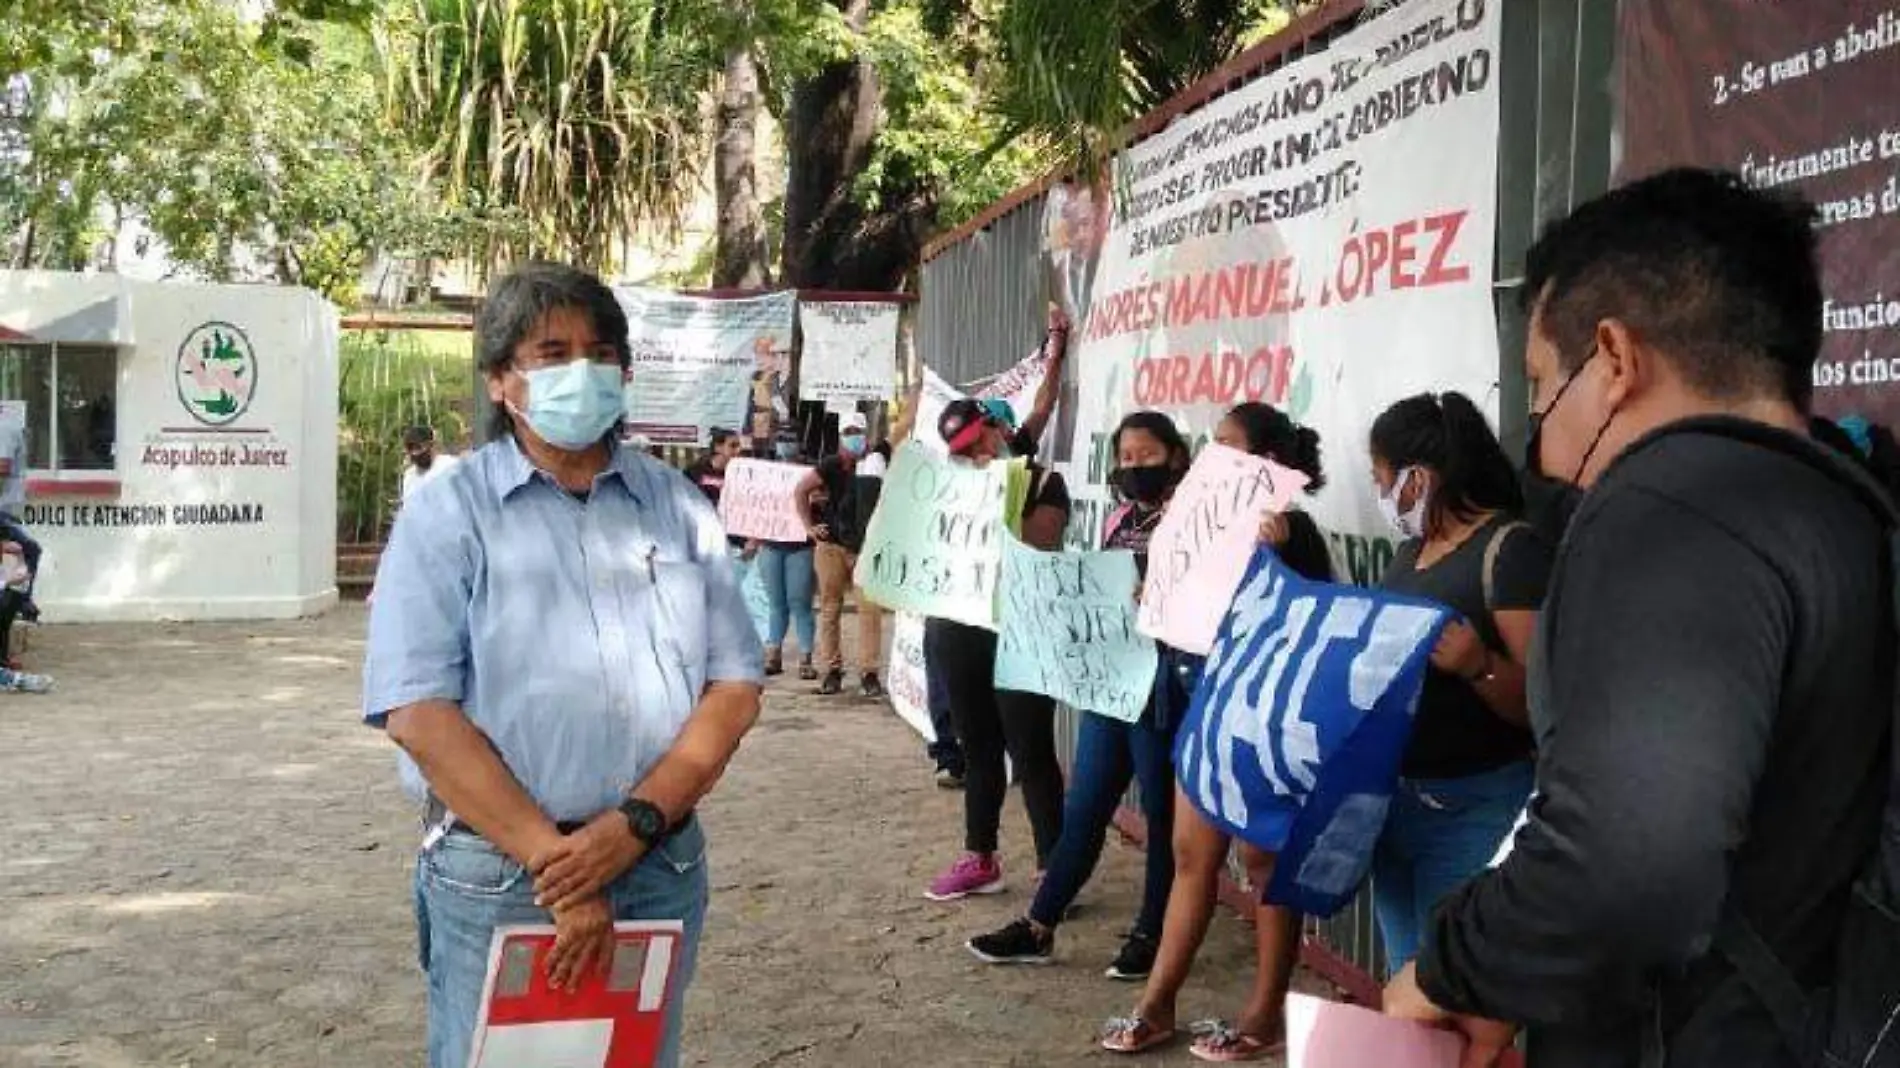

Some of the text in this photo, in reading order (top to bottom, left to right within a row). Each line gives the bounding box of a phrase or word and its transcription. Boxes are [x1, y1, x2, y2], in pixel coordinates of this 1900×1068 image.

[1814, 46, 1827, 70] a
[1346, 48, 1491, 141] GOBIERNO
[1086, 271, 1162, 342] ANDRÉS
[1133, 345, 1294, 406] OBRADOR
[143, 443, 216, 470] Acapulco
[220, 444, 236, 466] de
[22, 503, 65, 526] DULO
[73, 504, 89, 526] DE
[173, 503, 264, 526] CIUDADANA
